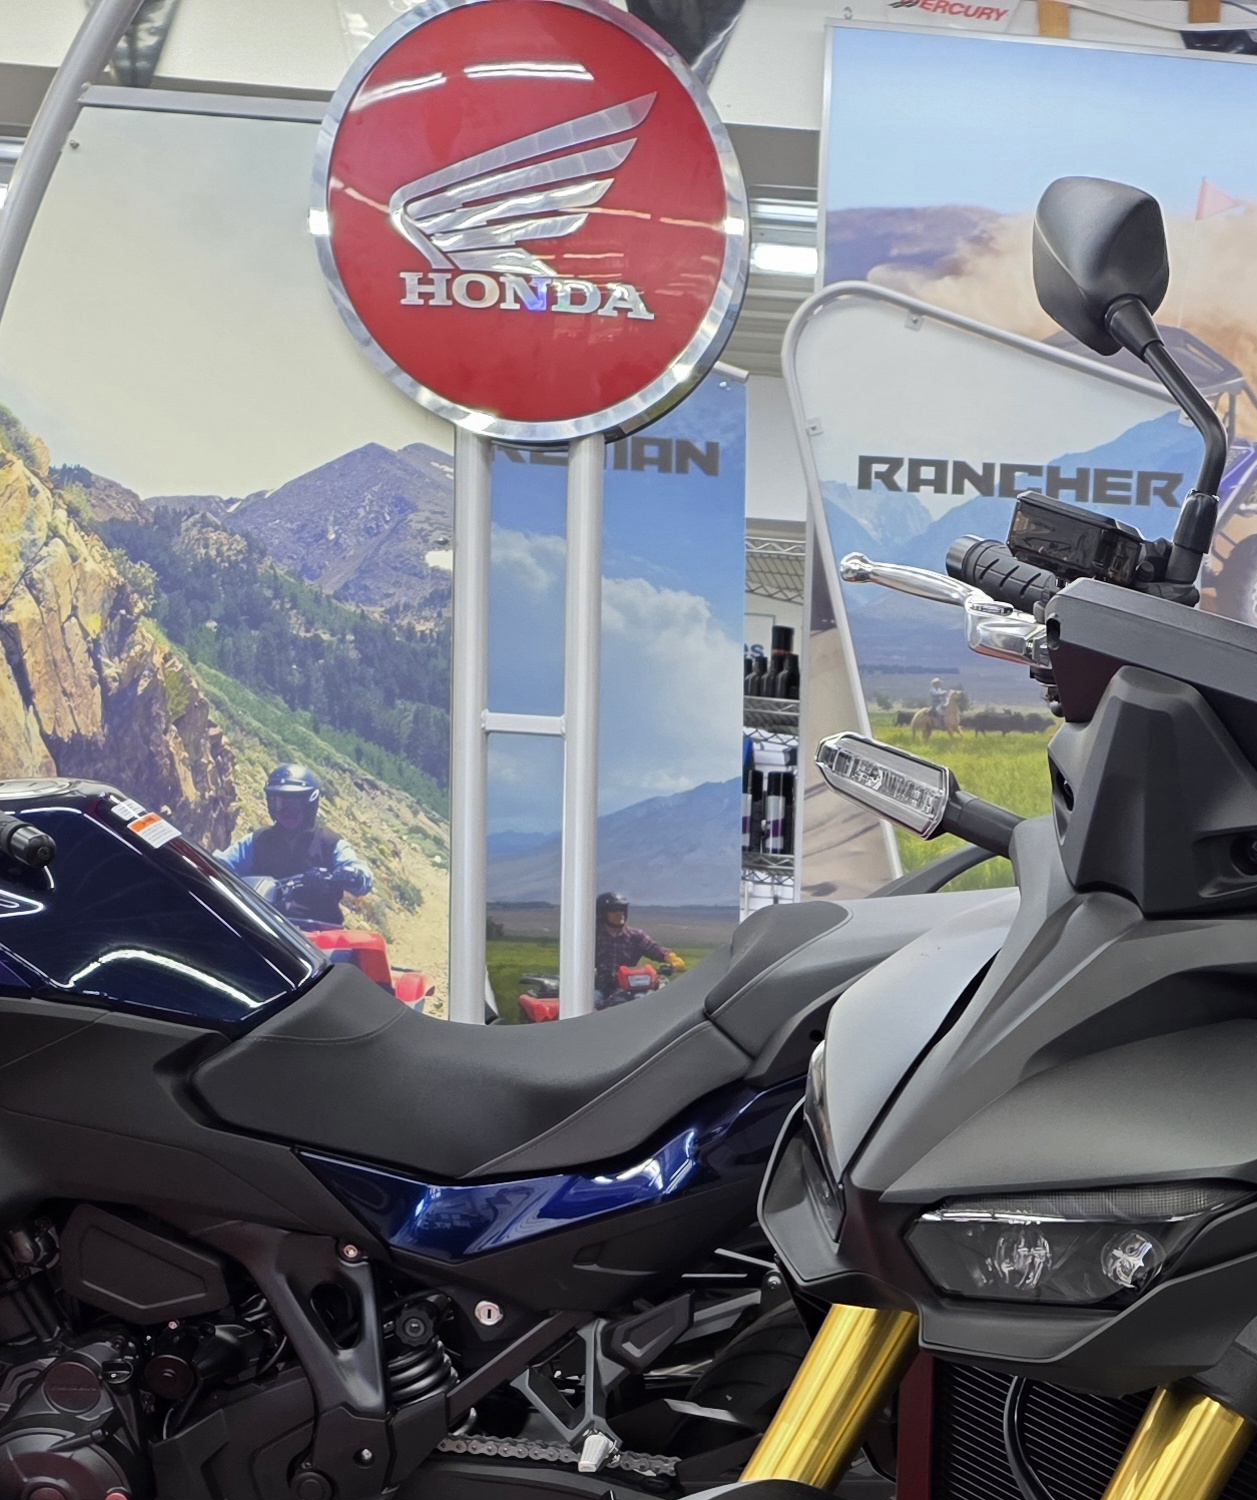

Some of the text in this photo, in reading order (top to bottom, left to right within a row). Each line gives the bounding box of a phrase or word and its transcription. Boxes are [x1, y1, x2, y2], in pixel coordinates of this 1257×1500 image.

[908, 0, 1009, 21] ERCURY
[399, 271, 655, 320] HONDA
[857, 455, 1184, 508] RANCHER
